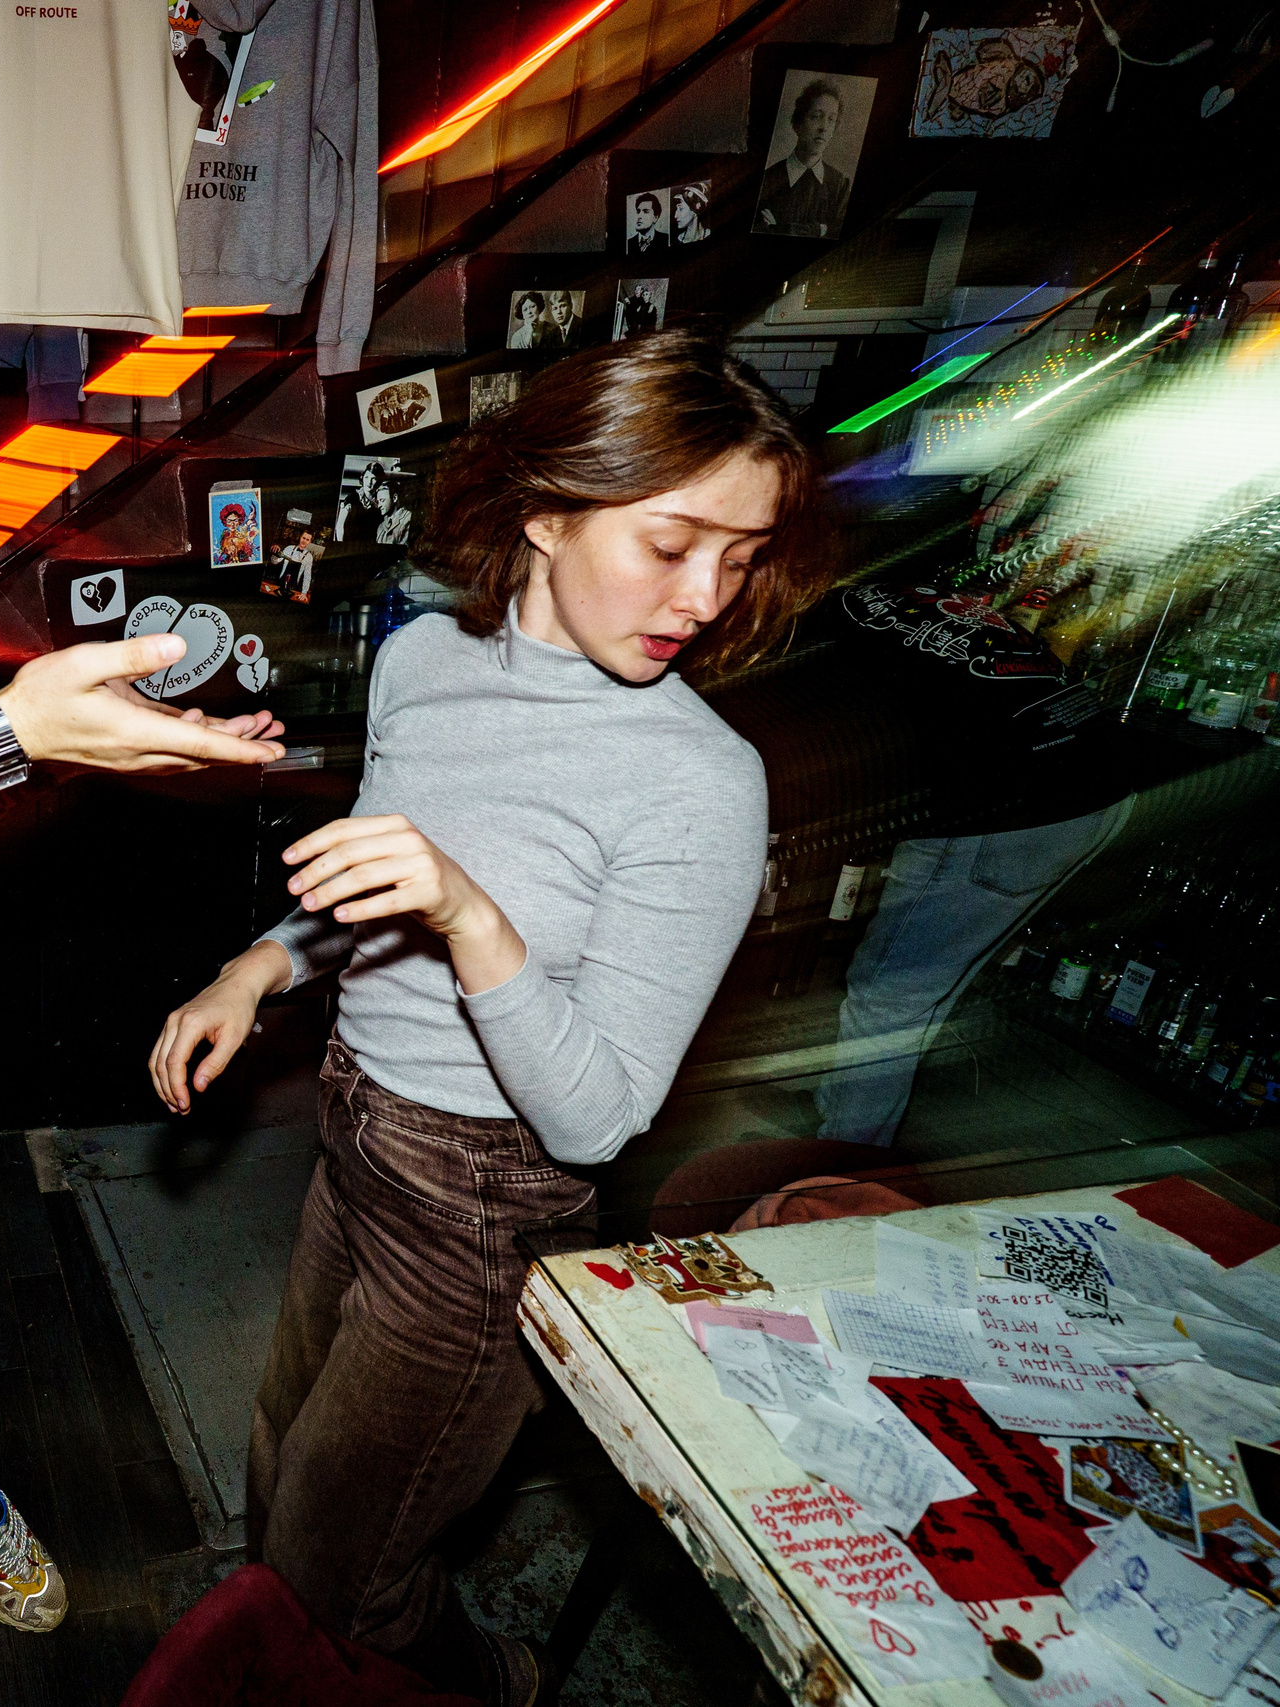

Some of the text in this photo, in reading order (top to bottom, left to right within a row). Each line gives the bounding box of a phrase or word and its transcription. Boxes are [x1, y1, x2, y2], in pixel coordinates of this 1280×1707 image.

[15, 6, 78, 19] OFF ROUTE
[199, 161, 258, 182] FRESH
[185, 182, 246, 202] HOUSE
[131, 601, 176, 628] сердец
[167, 607, 228, 691] бильярдный бар
[982, 1317, 1078, 1336] ОТ АРТЁМ
[1014, 1340, 1072, 1359] БАРА
[1019, 1358, 1110, 1377] ЛЕГЕНДЫ
[1008, 1372, 1126, 1395] ВЫ ЛУЧШИЕ
[781, 1507, 843, 1528] всегда
[836, 1562, 911, 1589] люблю
[834, 1580, 934, 1610] Я тебя
